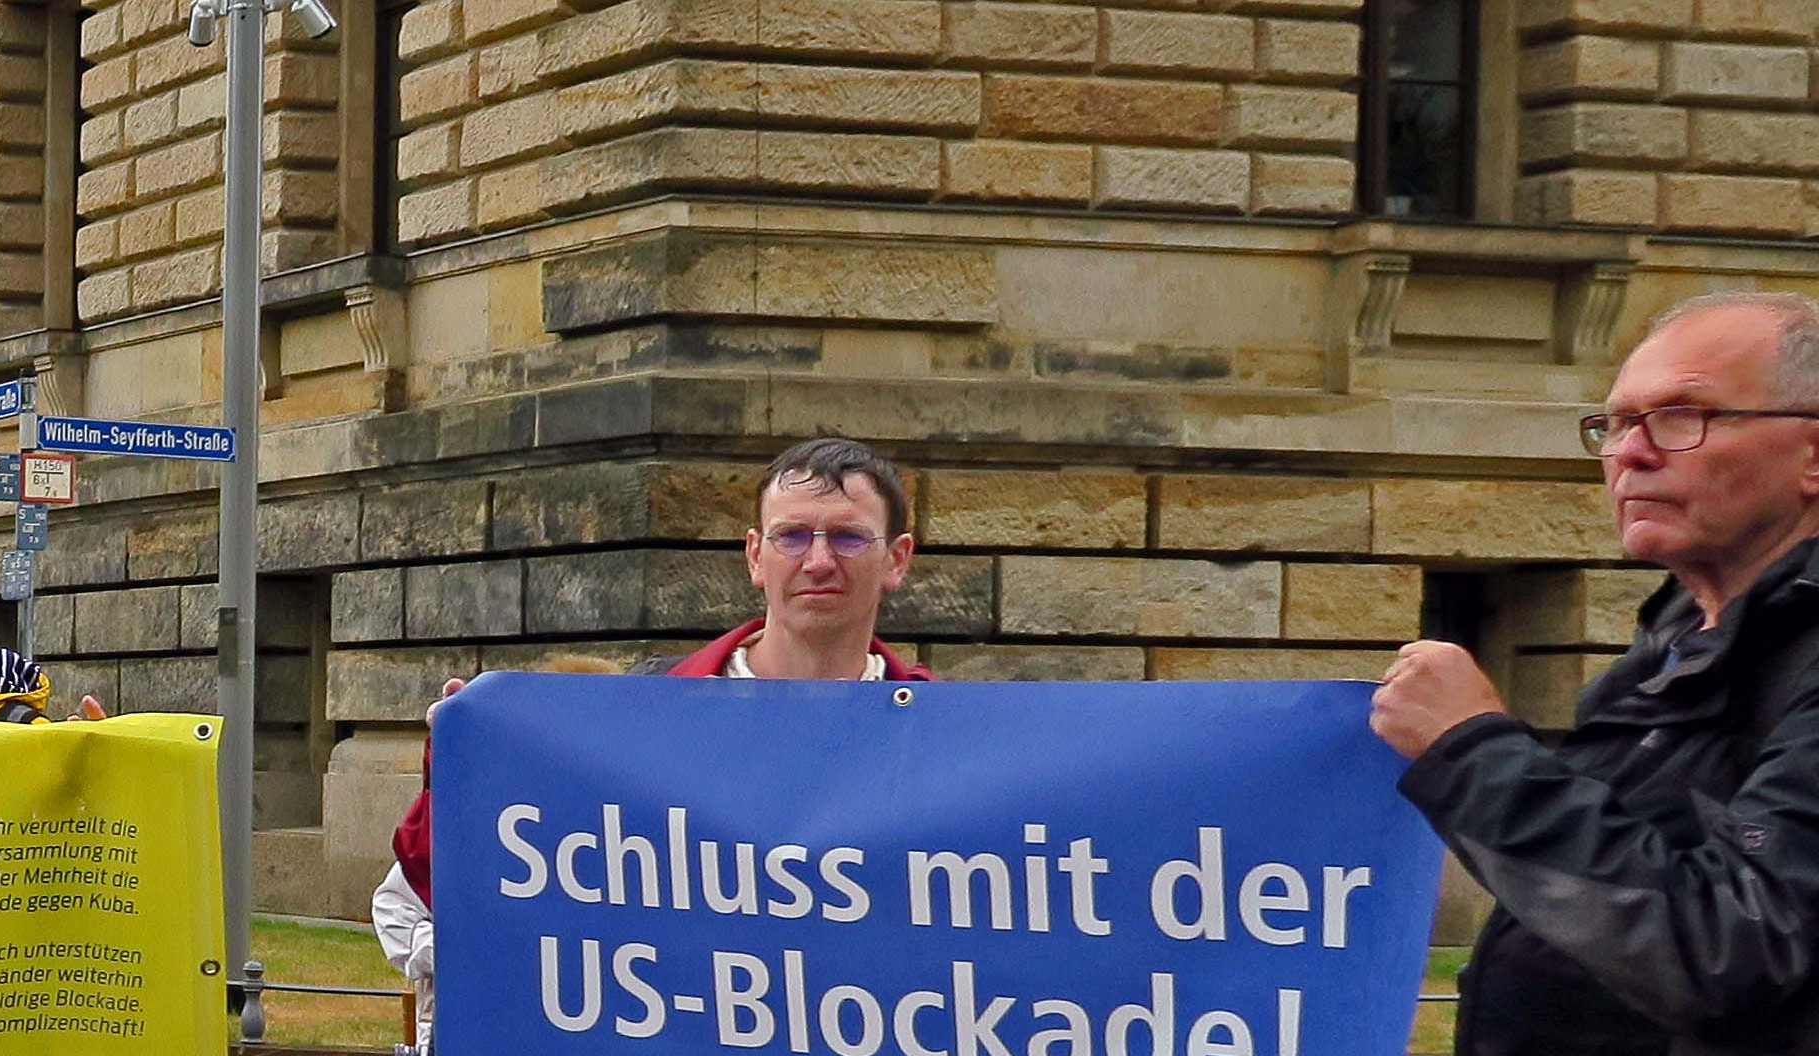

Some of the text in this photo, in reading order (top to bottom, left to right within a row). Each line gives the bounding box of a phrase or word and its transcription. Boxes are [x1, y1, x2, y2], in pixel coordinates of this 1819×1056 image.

[44, 421, 230, 452] Wilhelm-Seyfferth-Straße
[20, 816, 106, 836] verurteilt
[111, 820, 138, 838] die
[108, 846, 138, 864] mit
[23, 867, 107, 886] Mehrheit
[113, 870, 139, 889] die
[496, 803, 1373, 948] Schluss mit der
[27, 893, 83, 913] gegen
[89, 893, 140, 915] Kuba.
[24, 941, 142, 964] unterstützen
[57, 965, 143, 989] weiterhin
[55, 989, 144, 1013] Blockade.
